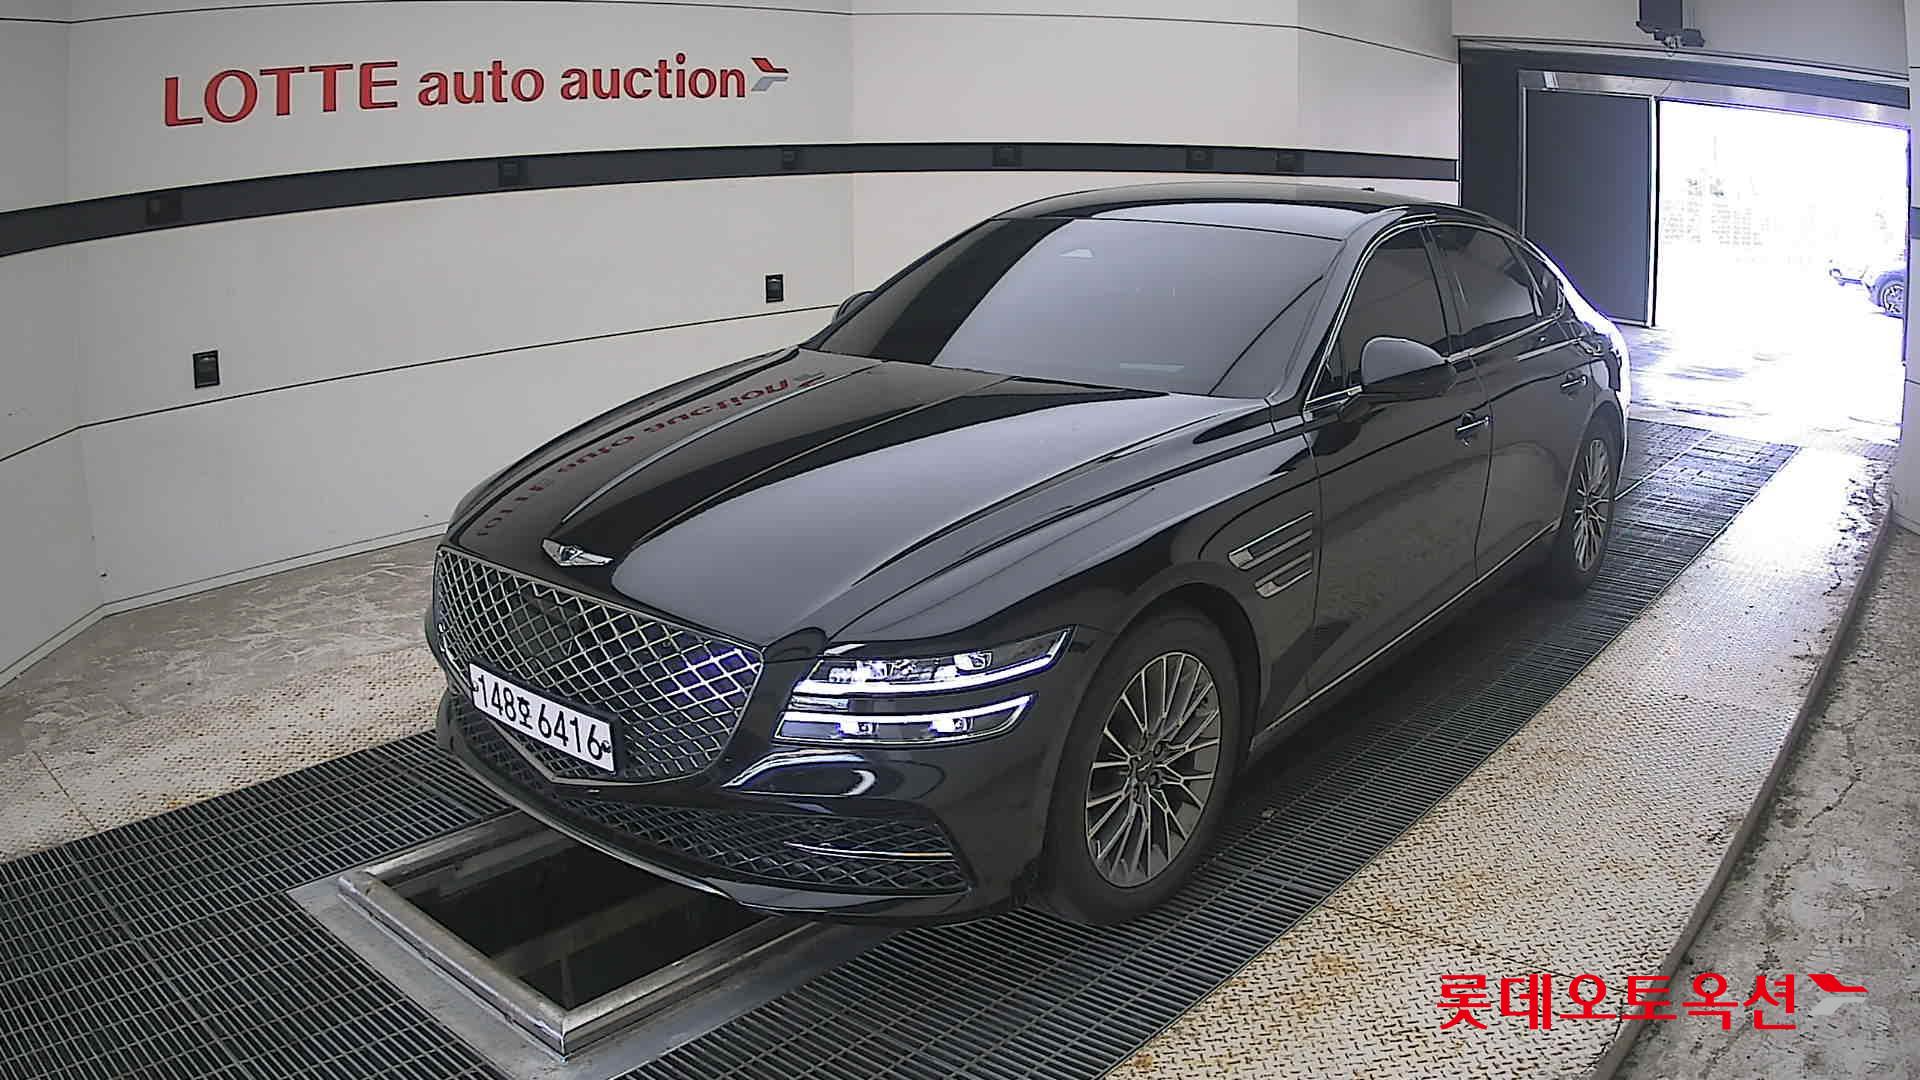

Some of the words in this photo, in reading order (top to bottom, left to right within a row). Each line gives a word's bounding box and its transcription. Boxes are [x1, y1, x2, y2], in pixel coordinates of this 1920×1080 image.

[163, 61, 399, 127] LOTTE
[417, 59, 545, 107] auto
[559, 53, 747, 100] auction
[477, 674, 534, 731] 148호
[537, 703, 604, 761] 6416
